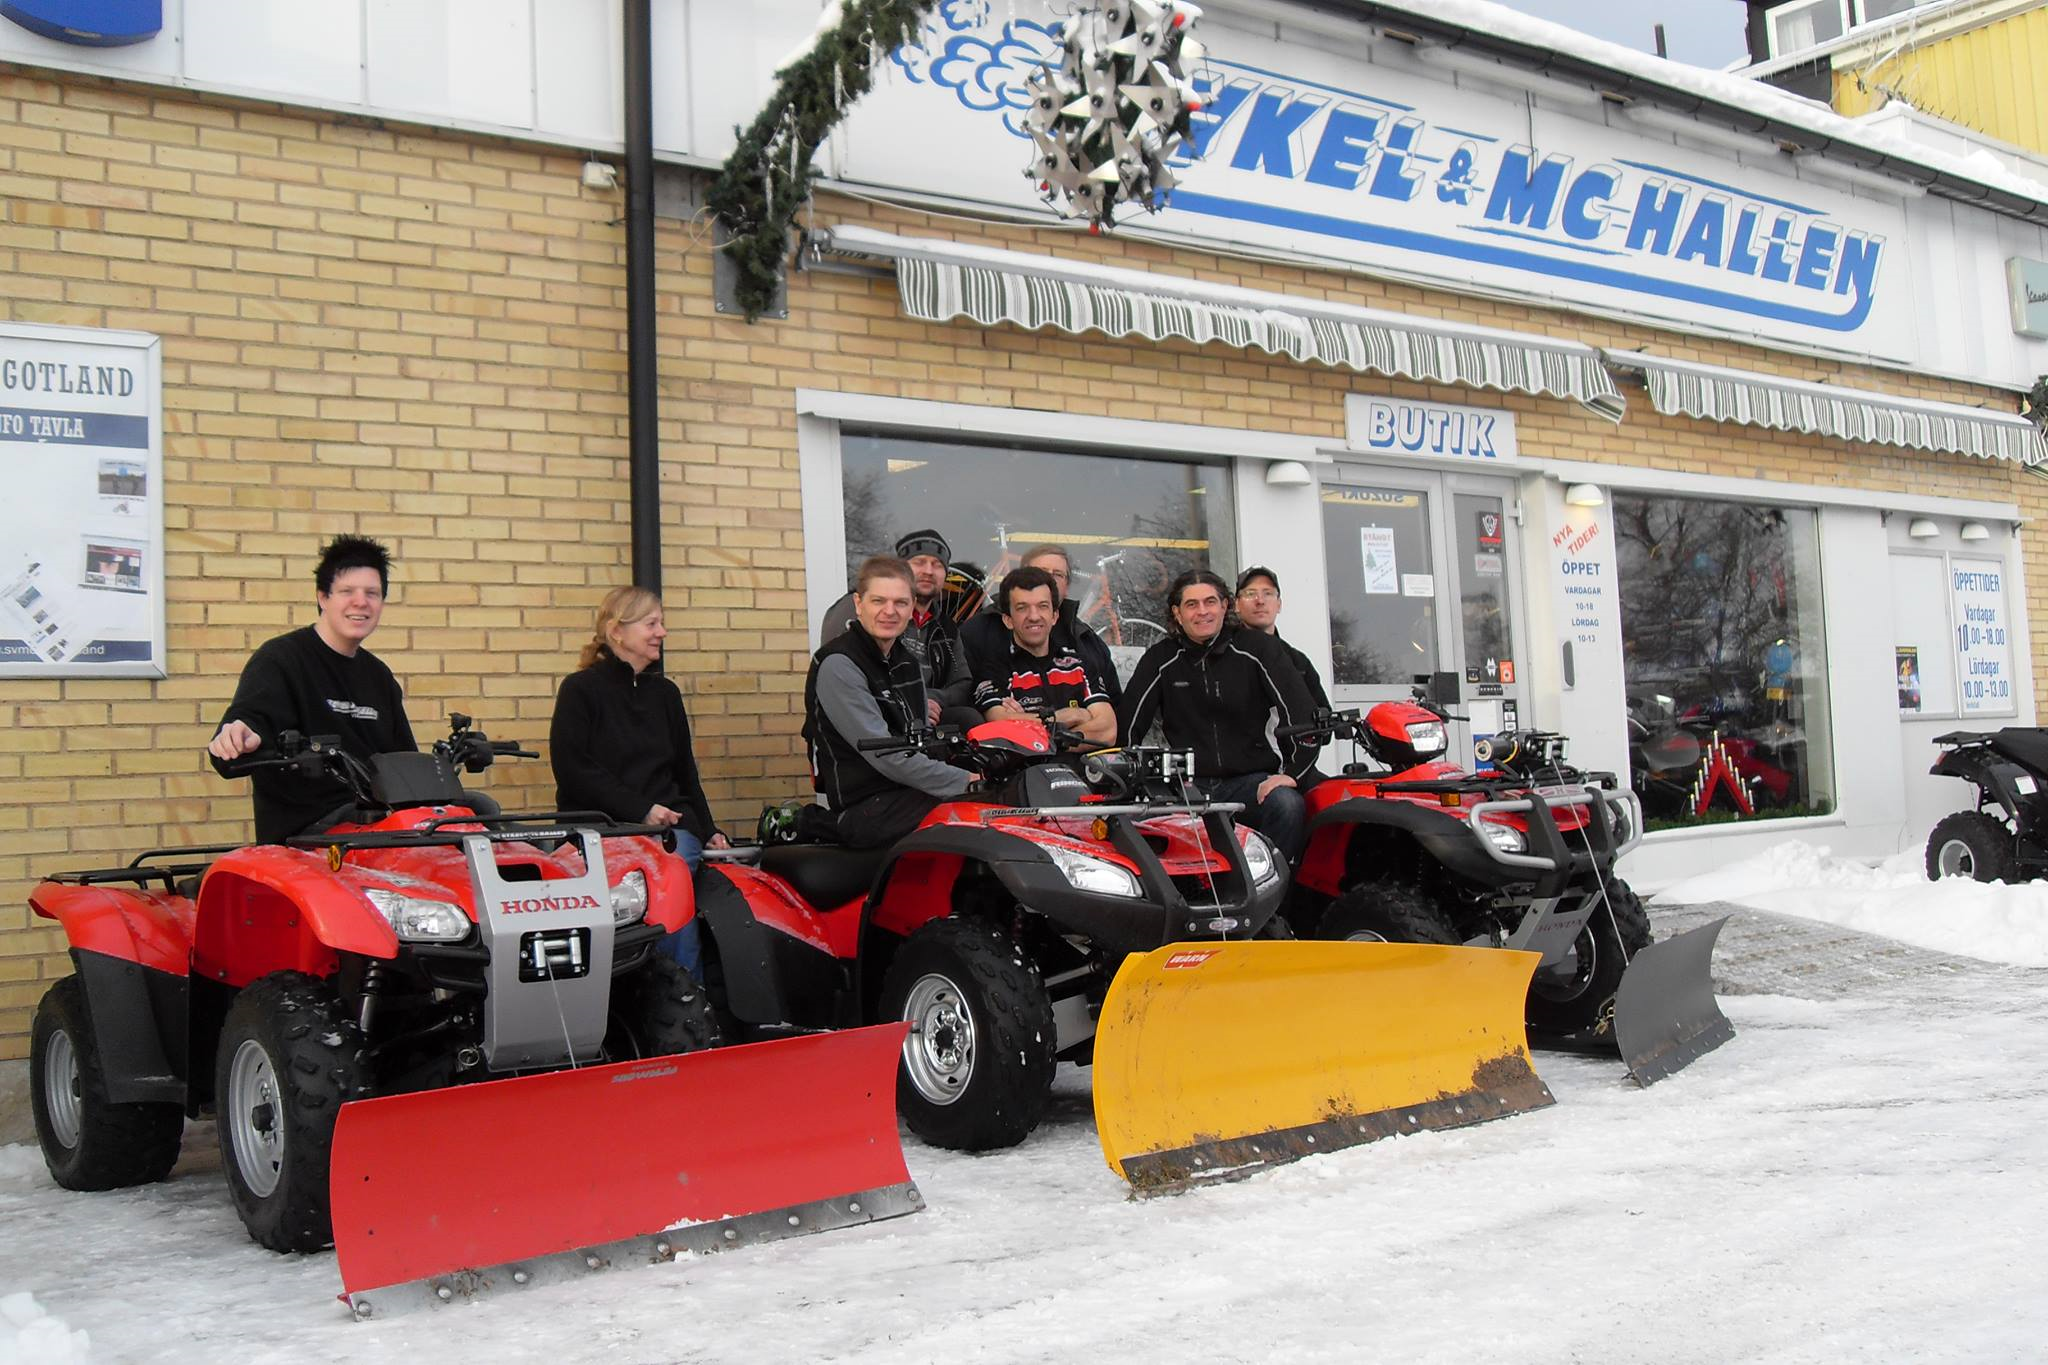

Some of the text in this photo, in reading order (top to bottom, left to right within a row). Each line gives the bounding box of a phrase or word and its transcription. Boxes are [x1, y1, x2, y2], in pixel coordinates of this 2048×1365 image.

[1176, 68, 1426, 202] YKEL
[2, 359, 133, 397] GOTLAND
[0, 413, 84, 438] FO TAVLA
[1369, 403, 1496, 457] BUTIK
[1553, 524, 1574, 547] NYA
[1568, 522, 1600, 555] TIDER!
[1562, 559, 1601, 575] ÖPPET
[1565, 585, 1601, 595] VARDAGAR
[1954, 568, 2000, 592] ÖPPETTIDER
[1576, 602, 1594, 611] 10-18
[1964, 603, 1996, 624] Vardagar
[1578, 635, 1596, 643] 10-13
[1969, 657, 2000, 677] Lördagar
[501, 895, 601, 915] HONDA
